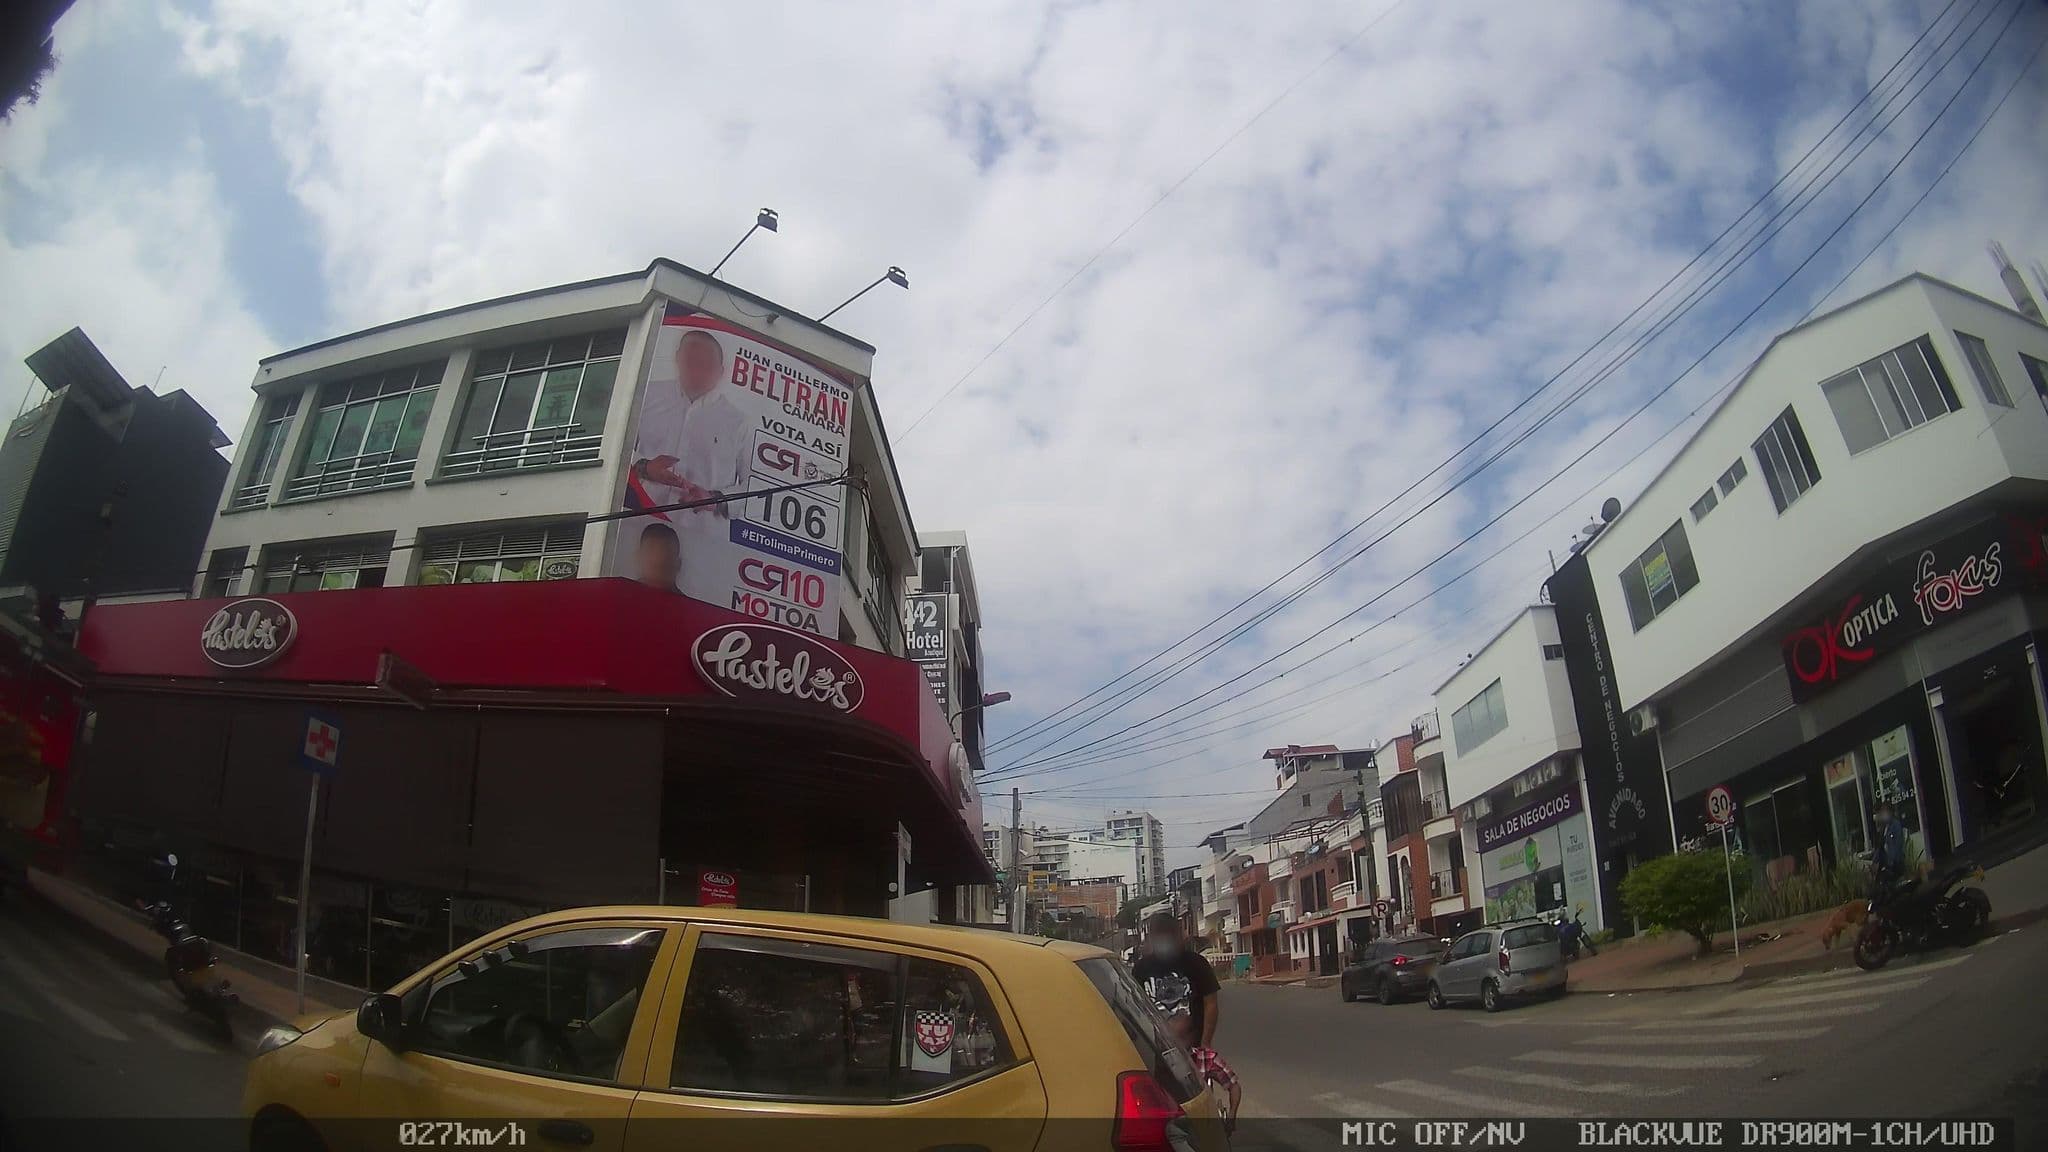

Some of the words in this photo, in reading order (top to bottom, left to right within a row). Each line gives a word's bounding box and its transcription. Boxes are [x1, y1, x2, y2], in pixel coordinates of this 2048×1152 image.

[736, 347, 770, 367] JUAN
[774, 362, 849, 400] GUILLERMO
[761, 415, 807, 444] VOTA
[811, 437, 843, 458] ASÍ
[757, 488, 827, 540] 106
[741, 528, 835, 567] #ElTolimaPrimero
[906, 629, 944, 650] Hotel
[1585, 612, 1603, 671] CENTRO
[1781, 593, 1875, 684] OK
[1843, 593, 1899, 648] OPTICA
[1599, 675, 1609, 697] DE
[1603, 699, 1624, 782] NEGOCIOS
[1484, 823, 1506, 844] SALA
[1506, 817, 1519, 835] DE
[1519, 794, 1570, 829] NEGOCIOS
[1711, 794, 1728, 814] 30
